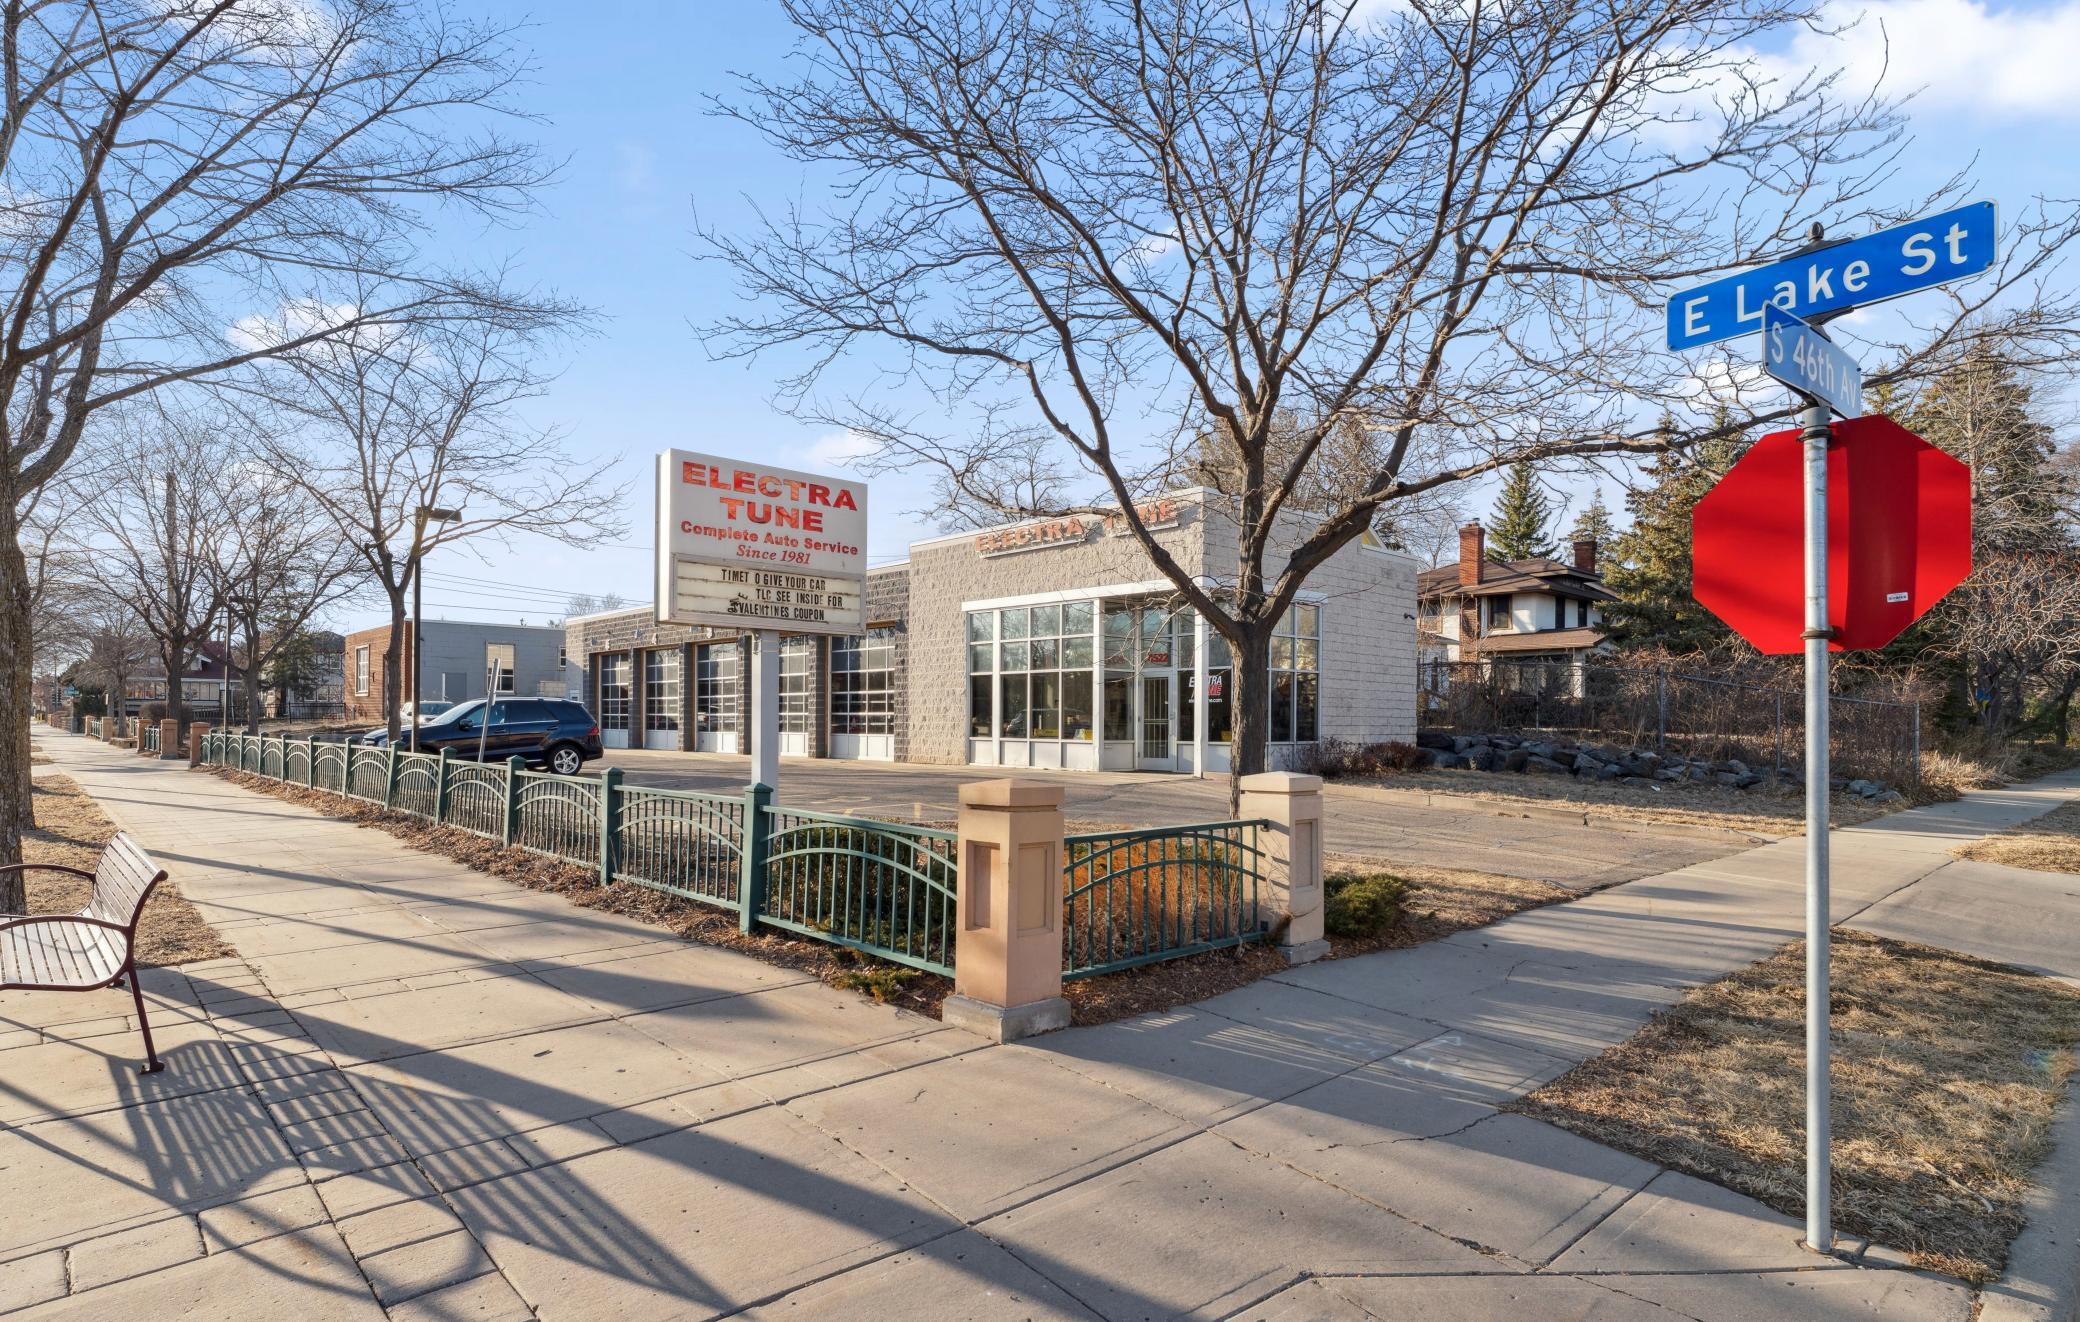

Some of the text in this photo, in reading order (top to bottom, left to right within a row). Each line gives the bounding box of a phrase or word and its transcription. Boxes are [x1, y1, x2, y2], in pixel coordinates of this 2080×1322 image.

[1684, 222, 1968, 337] E Lake St
[1771, 321, 1858, 409] S 46th Av
[682, 461, 858, 511] ELECTRA
[720, 497, 823, 533] TUNE
[680, 520, 858, 555] Complete Auto Service
[975, 517, 1085, 552] ELECTRA
[736, 545, 811, 565] Since 1981
[756, 588, 843, 607] TLC SEE INSIDE FOR
[764, 574, 782, 587] GIVE
[785, 575, 806, 589] YOUR
[810, 579, 826, 591] CAR
[794, 607, 825, 620] COUPON
